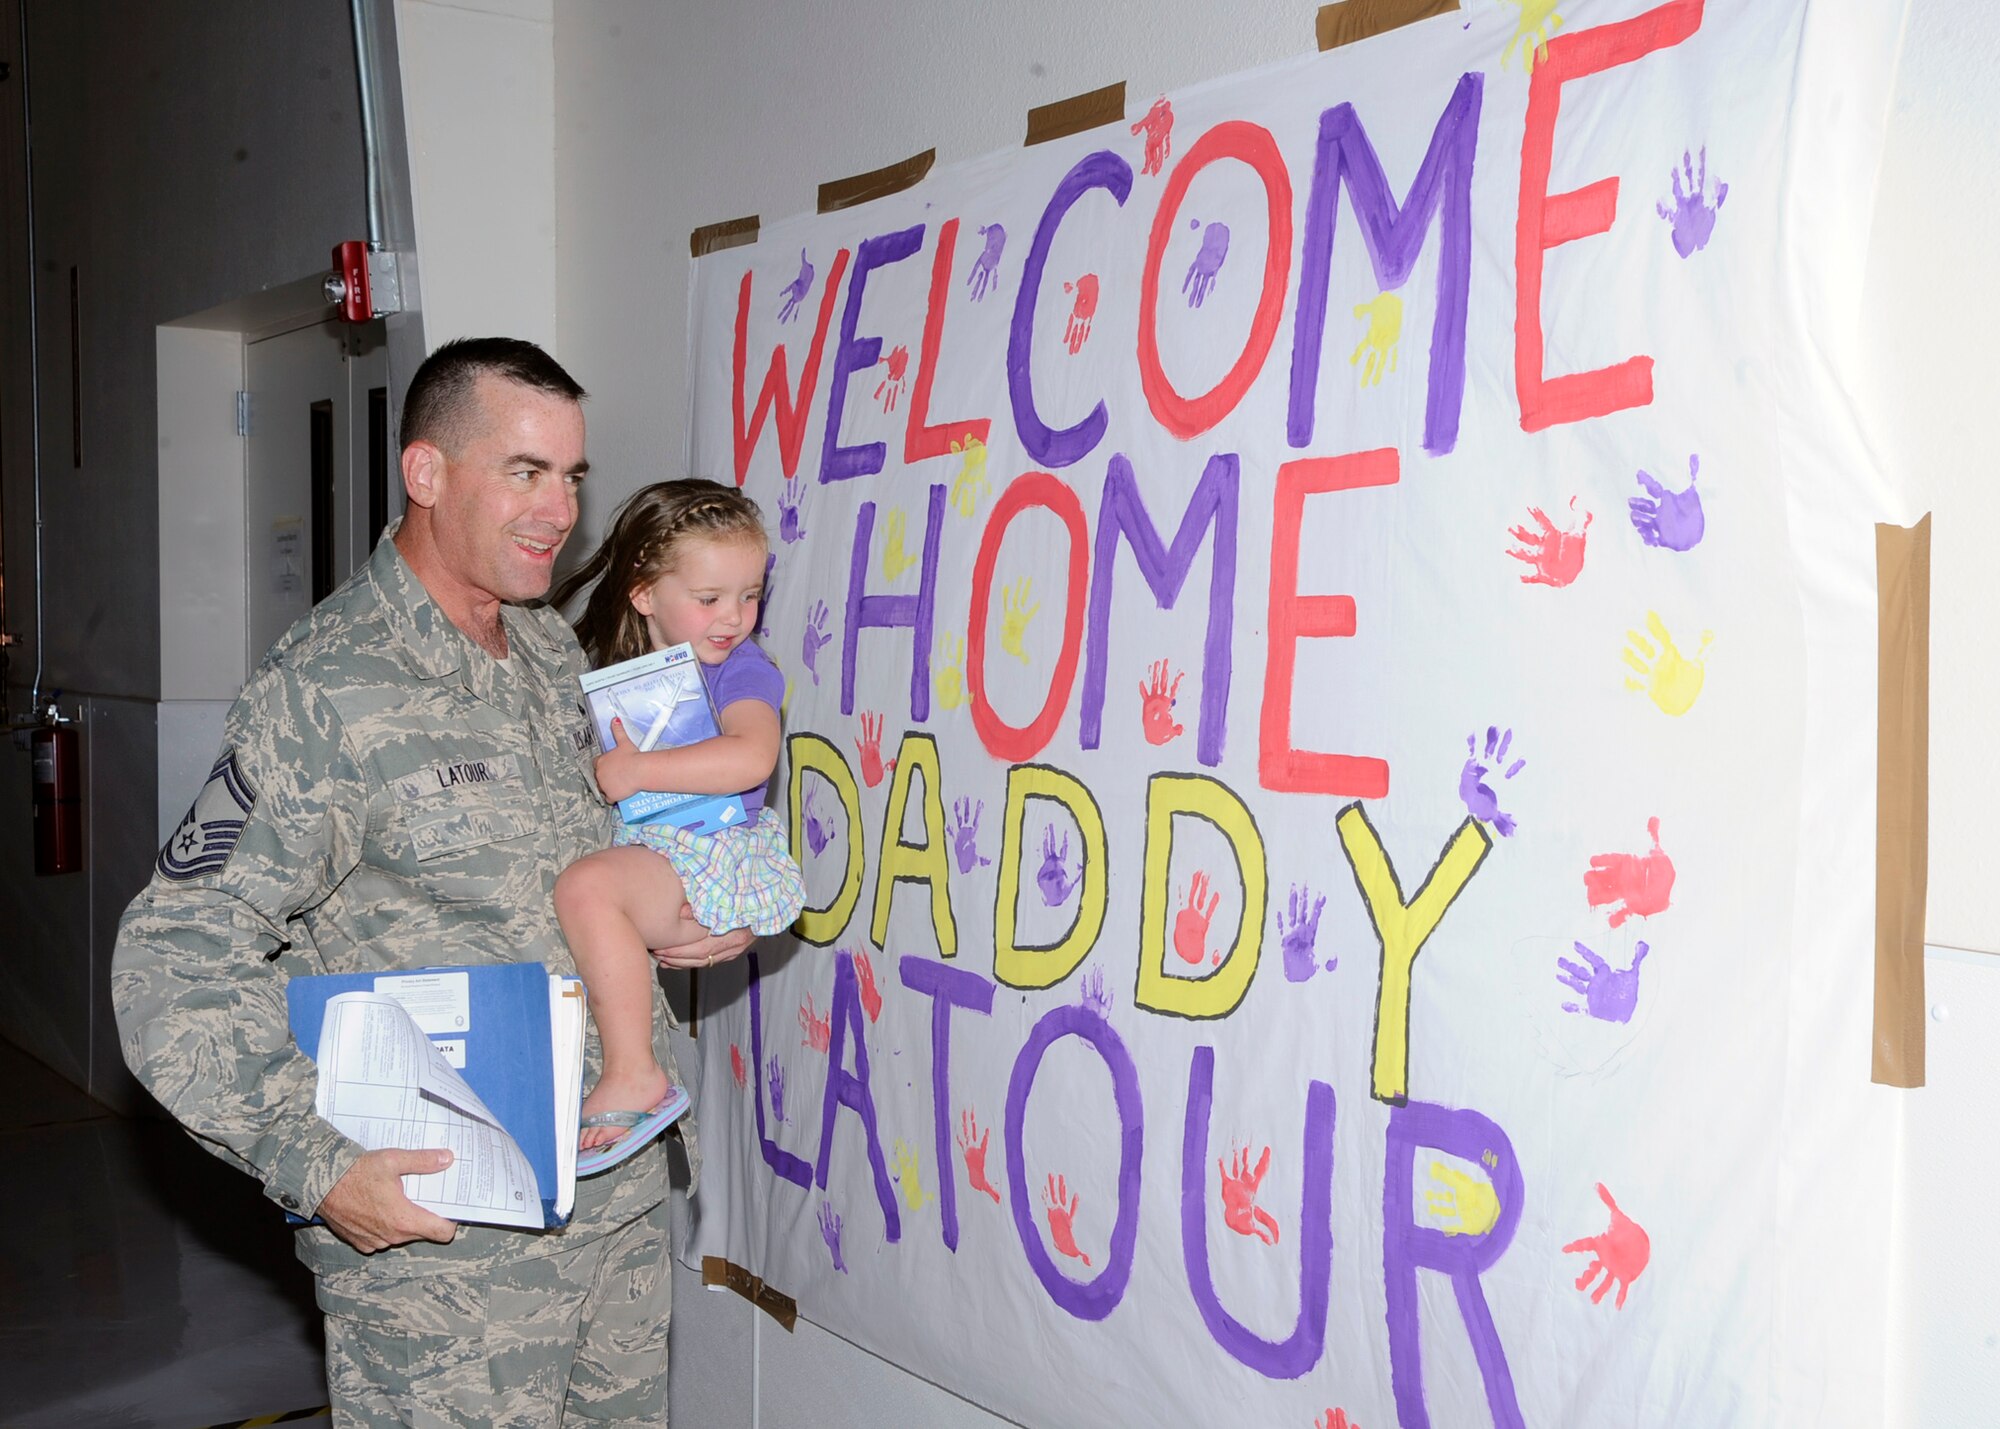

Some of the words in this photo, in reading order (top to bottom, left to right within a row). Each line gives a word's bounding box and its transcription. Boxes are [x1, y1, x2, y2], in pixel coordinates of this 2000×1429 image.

[352, 268, 362, 304] FIRE
[732, 0, 1705, 486] WELCOME
[435, 761, 490, 789] LATOUR
[840, 447, 1400, 800] HOME
[787, 731, 1494, 1106] DADDY
[747, 948, 1525, 1429] LATOUR
